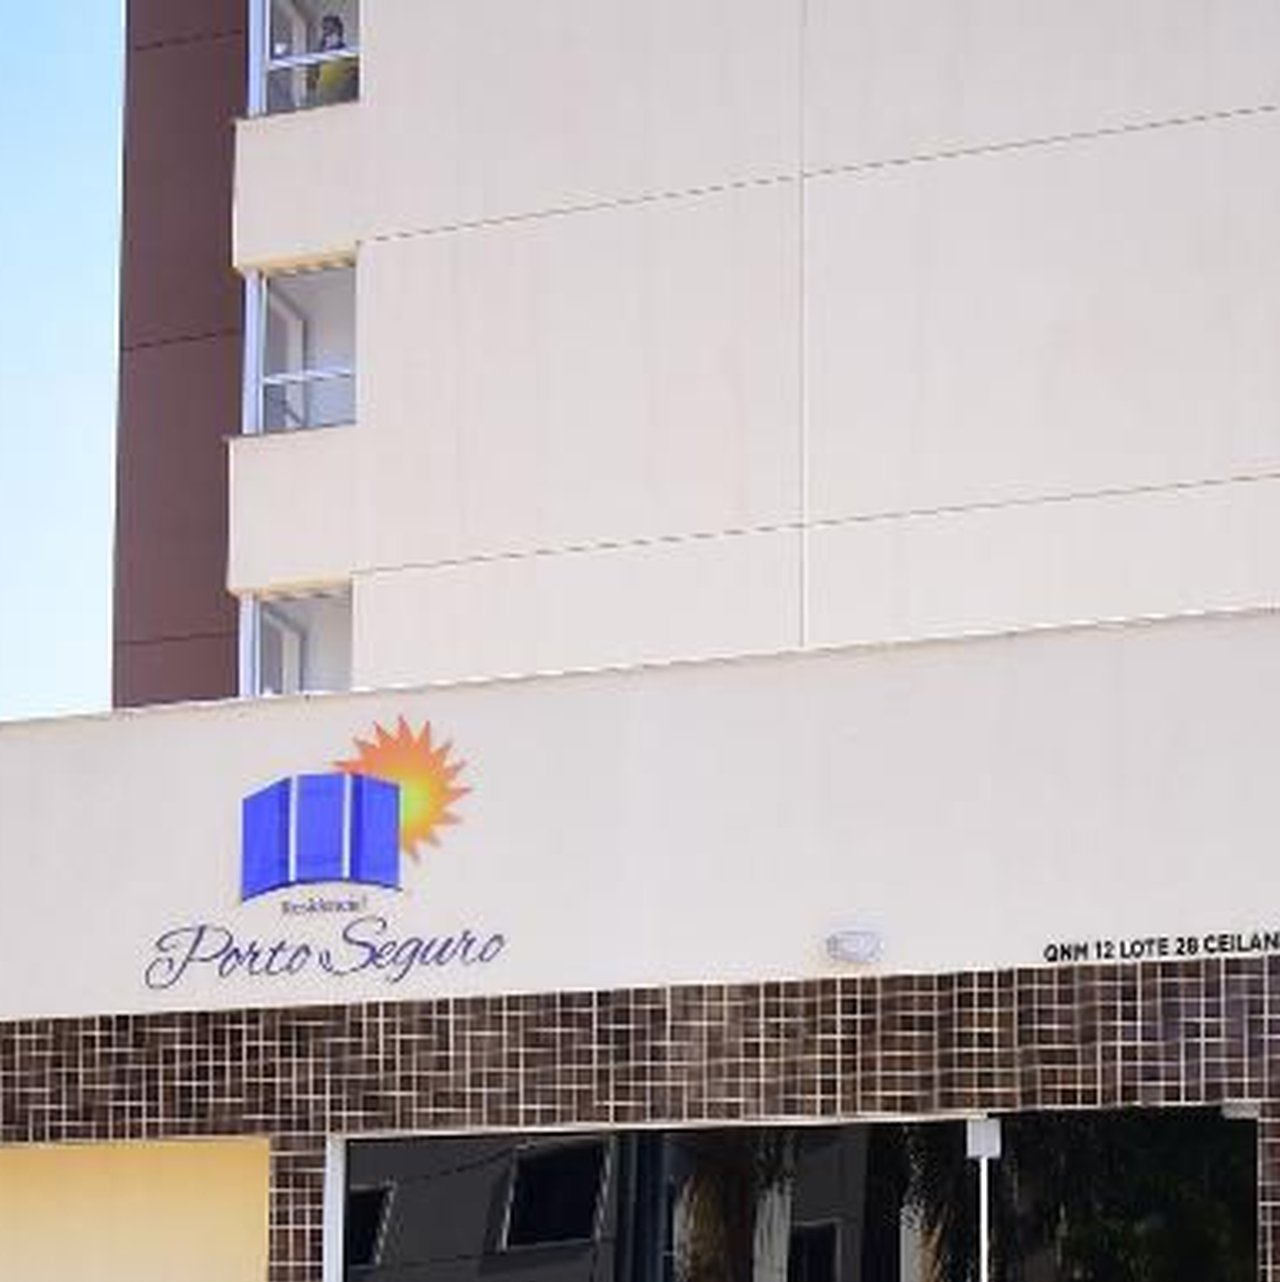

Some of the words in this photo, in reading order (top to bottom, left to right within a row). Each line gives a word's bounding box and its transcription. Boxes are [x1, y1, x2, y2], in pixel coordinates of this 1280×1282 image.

[144, 924, 312, 990] Porto
[318, 914, 506, 984] Seguro
[1043, 943, 1089, 962] QNM
[1096, 940, 1115, 960] 12
[1119, 937, 1169, 959] LOTE
